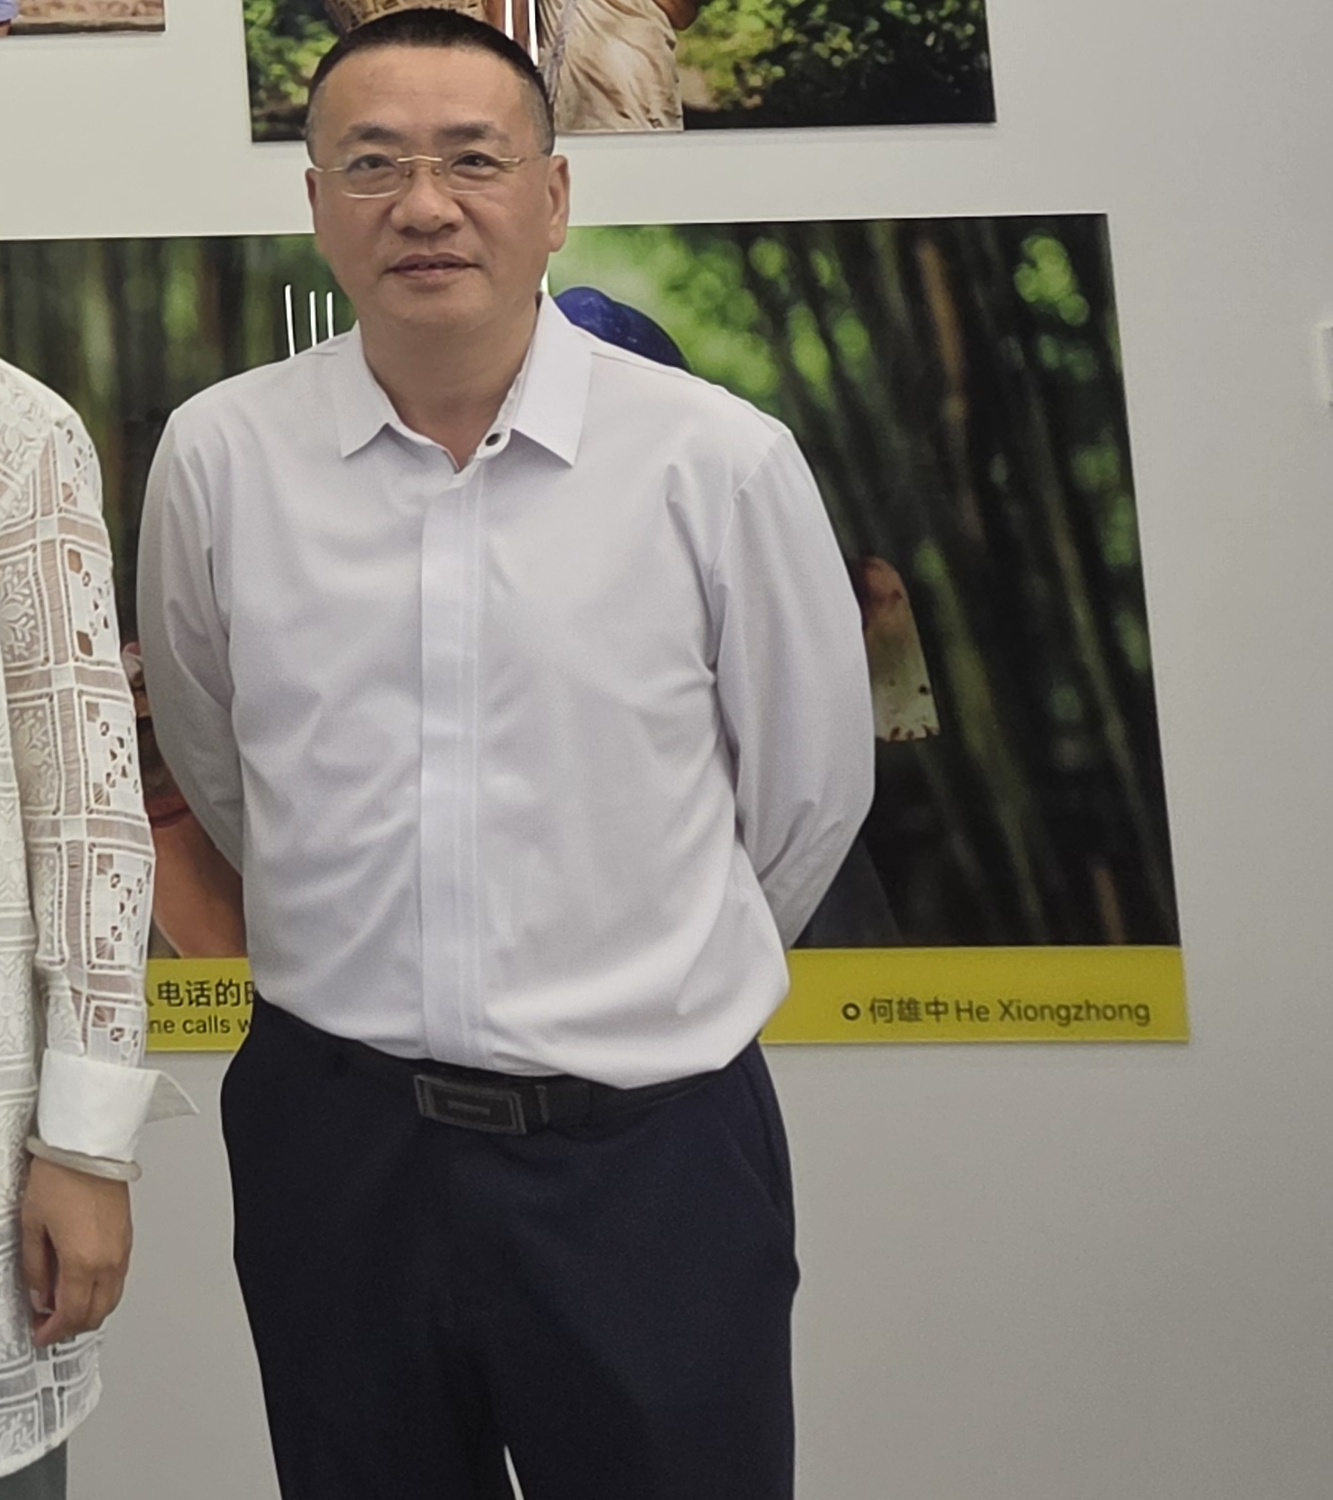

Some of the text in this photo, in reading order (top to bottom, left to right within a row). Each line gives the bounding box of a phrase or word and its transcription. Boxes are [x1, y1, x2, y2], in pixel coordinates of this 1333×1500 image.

[182, 1015, 231, 1035] calls
[869, 997, 1151, 1028] 何雄中 He Xiongzhong
